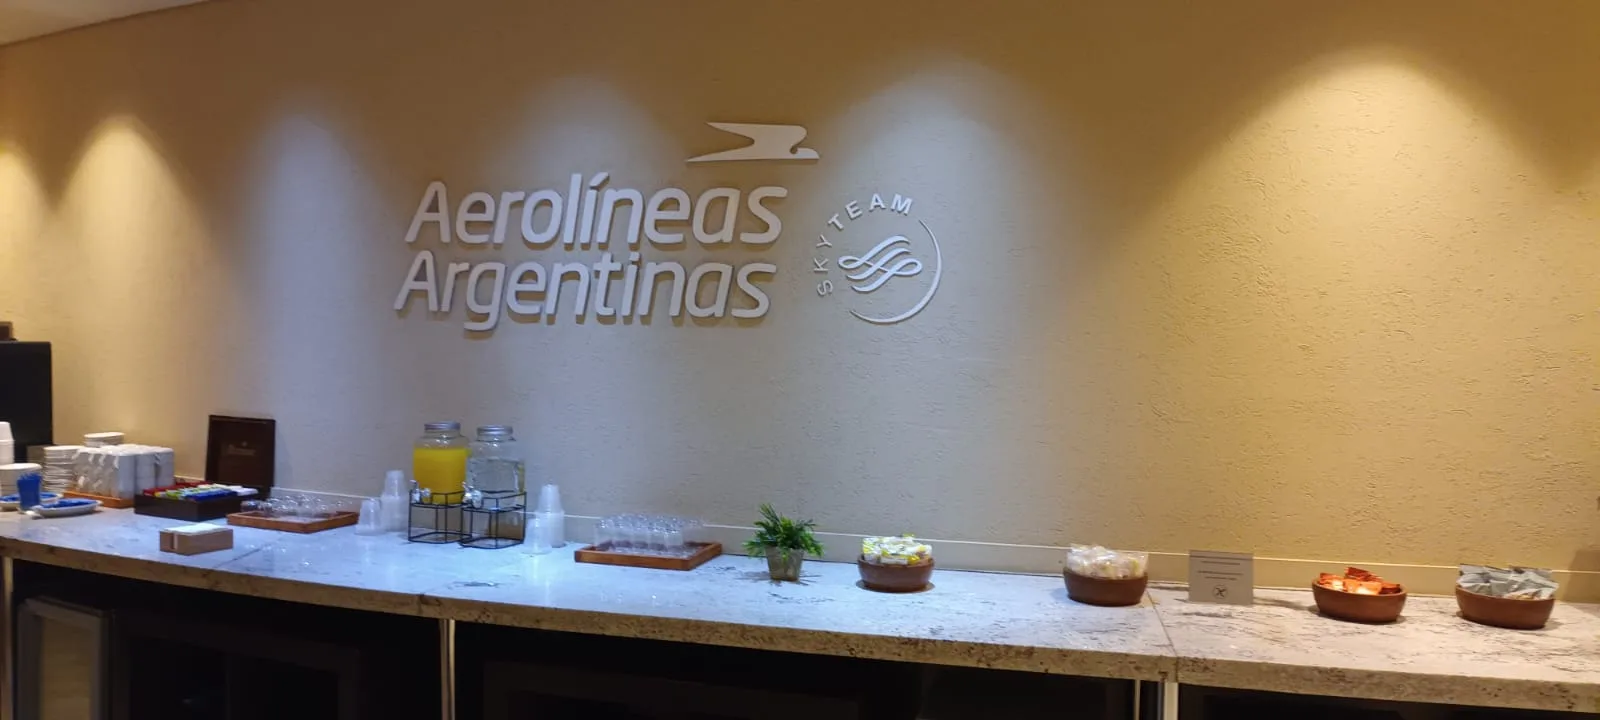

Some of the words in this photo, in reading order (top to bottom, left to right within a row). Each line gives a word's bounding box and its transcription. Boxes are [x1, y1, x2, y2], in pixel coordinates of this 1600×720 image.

[405, 172, 788, 246] Aerolíneas
[813, 192, 913, 297] SKYTEAM
[394, 249, 777, 332] Argentinas
